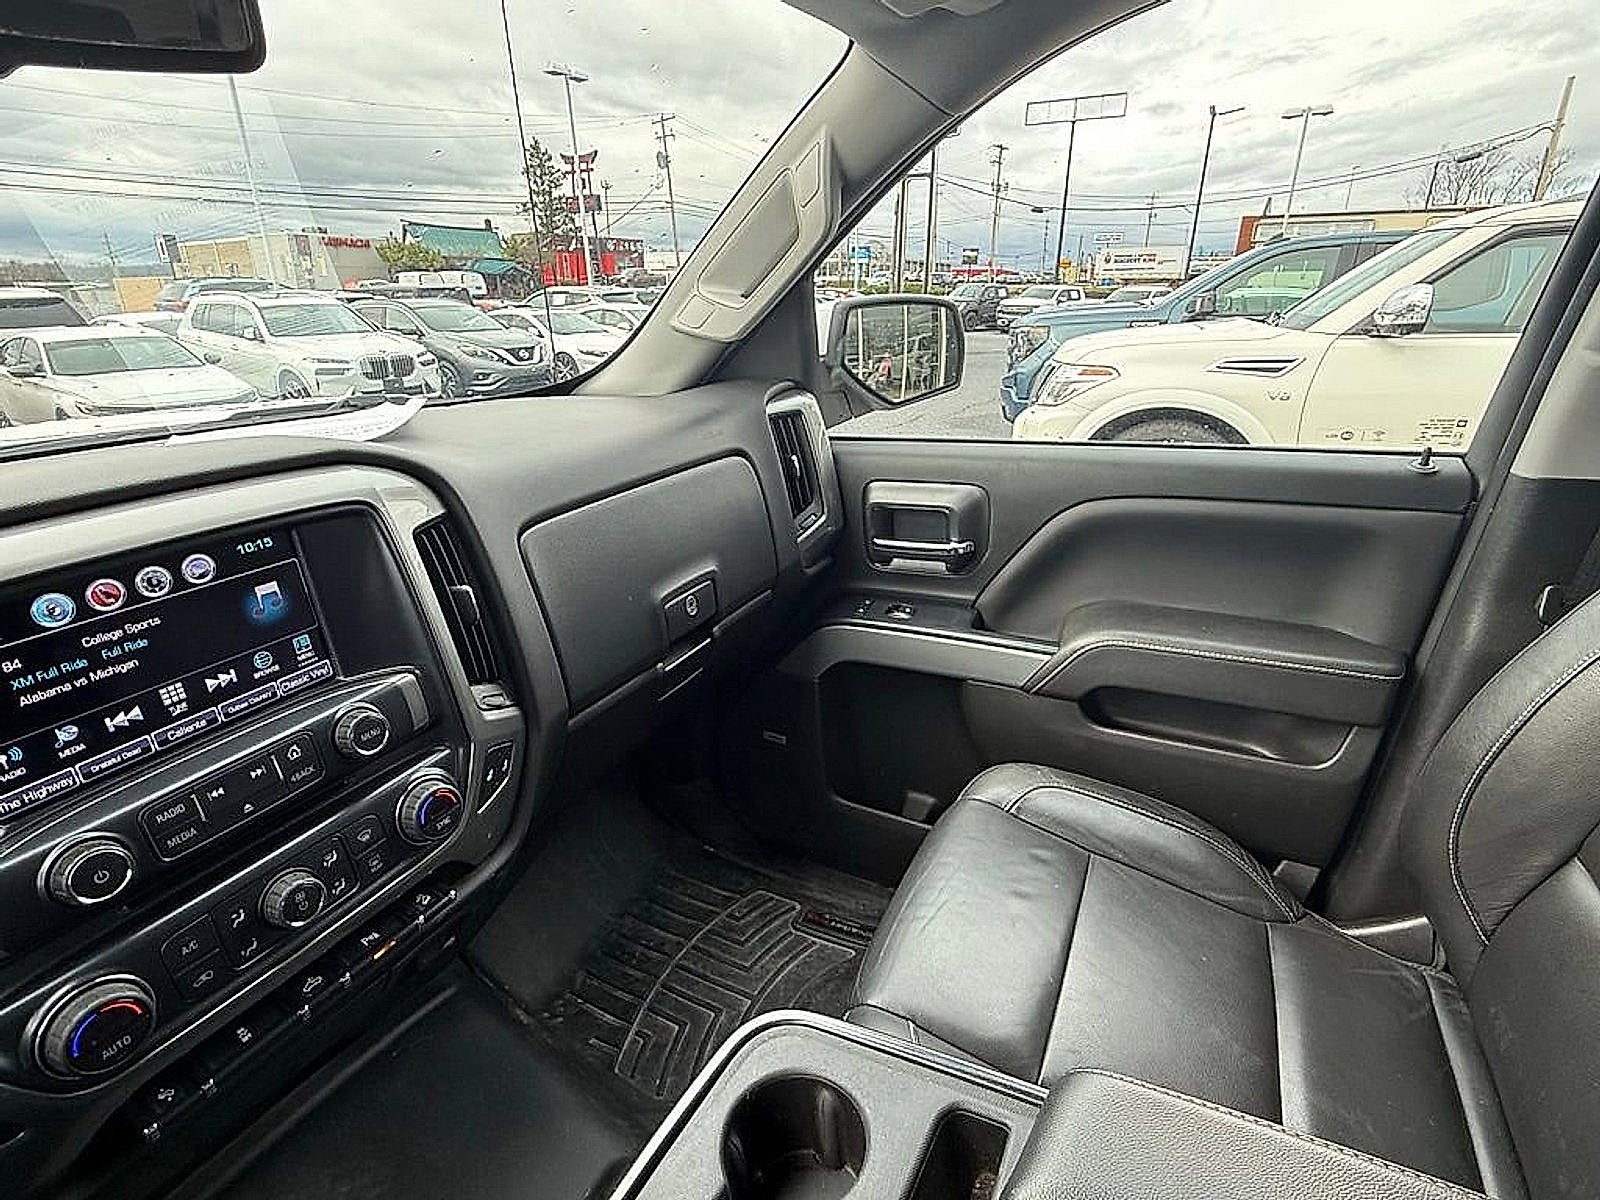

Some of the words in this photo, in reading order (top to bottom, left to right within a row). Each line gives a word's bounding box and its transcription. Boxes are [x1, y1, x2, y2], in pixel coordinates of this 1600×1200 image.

[81, 628, 124, 648] College
[124, 617, 161, 634] Sports
[101, 643, 122, 660] Full
[123, 638, 149, 653] Ride
[9, 674, 35, 690] XM
[35, 665, 59, 682] Full
[60, 658, 89, 673] Ride
[19, 681, 72, 707] Alabama
[73, 676, 88, 688] vs
[89, 659, 139, 682] Michigan
[281, 673, 310, 691] Classic
[310, 664, 329, 679] Vinyl
[167, 719, 207, 741] Caliente
[58, 743, 87, 758] MEDIA
[22, 776, 74, 803] Highway
[155, 803, 186, 824] RADIO
[167, 827, 197, 848] MEDIA
[182, 940, 199, 955] A/C
[102, 1035, 132, 1060] AUTO
